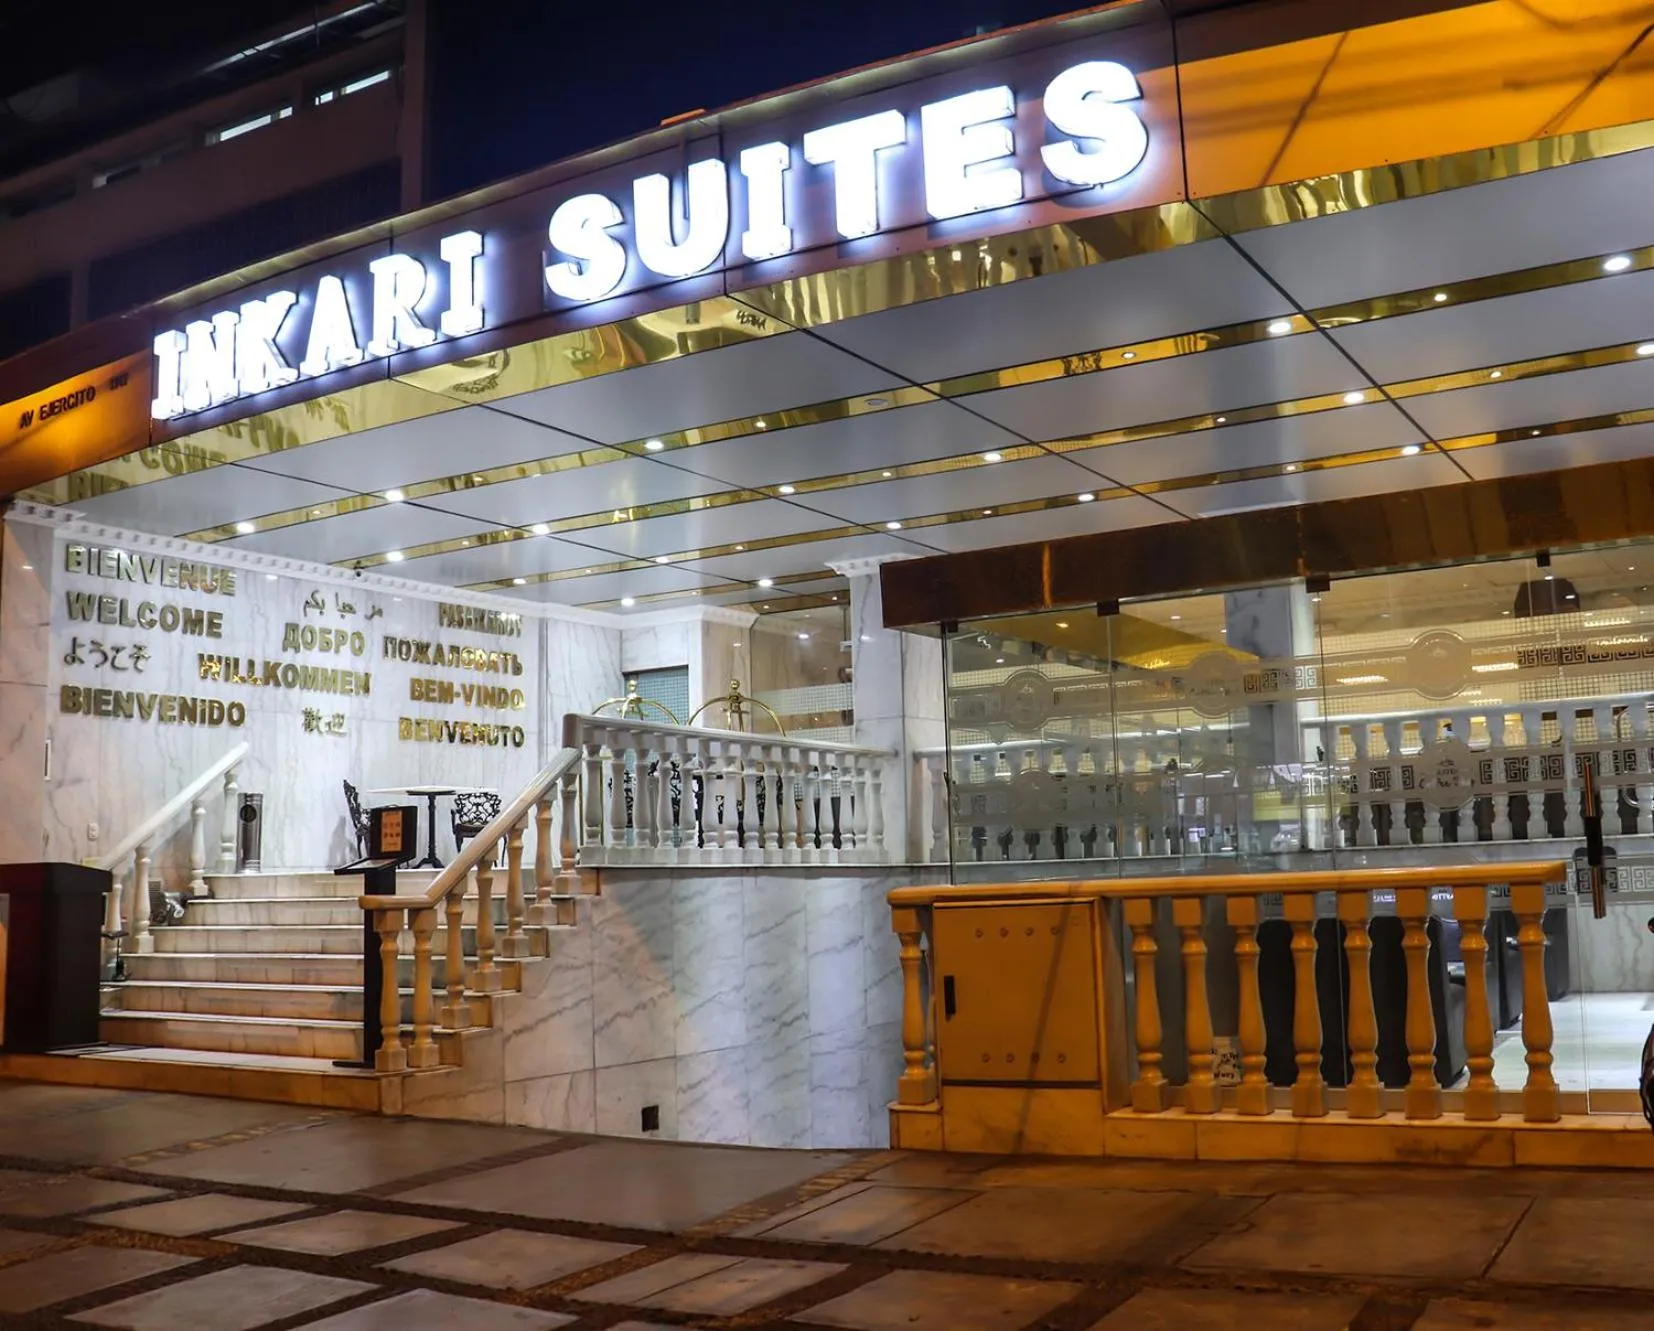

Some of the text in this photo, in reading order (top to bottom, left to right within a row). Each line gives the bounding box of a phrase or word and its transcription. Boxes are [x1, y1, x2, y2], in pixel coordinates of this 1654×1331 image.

[152, 60, 1149, 420] INKARI SUITES
[39, 386, 97, 420] EJERCITO
[66, 543, 236, 597] BIENVENUE
[66, 590, 224, 640] WELCOME
[62, 636, 152, 673] ようこそ
[282, 621, 524, 677] ДОБРО ПОЖАЛОВАТЬ
[197, 653, 372, 697] WILLKOMMEN
[409, 677, 526, 711] BEM-VINDO
[60, 683, 247, 728] BIENVENIDO
[398, 716, 526, 748] BENVENUTO
